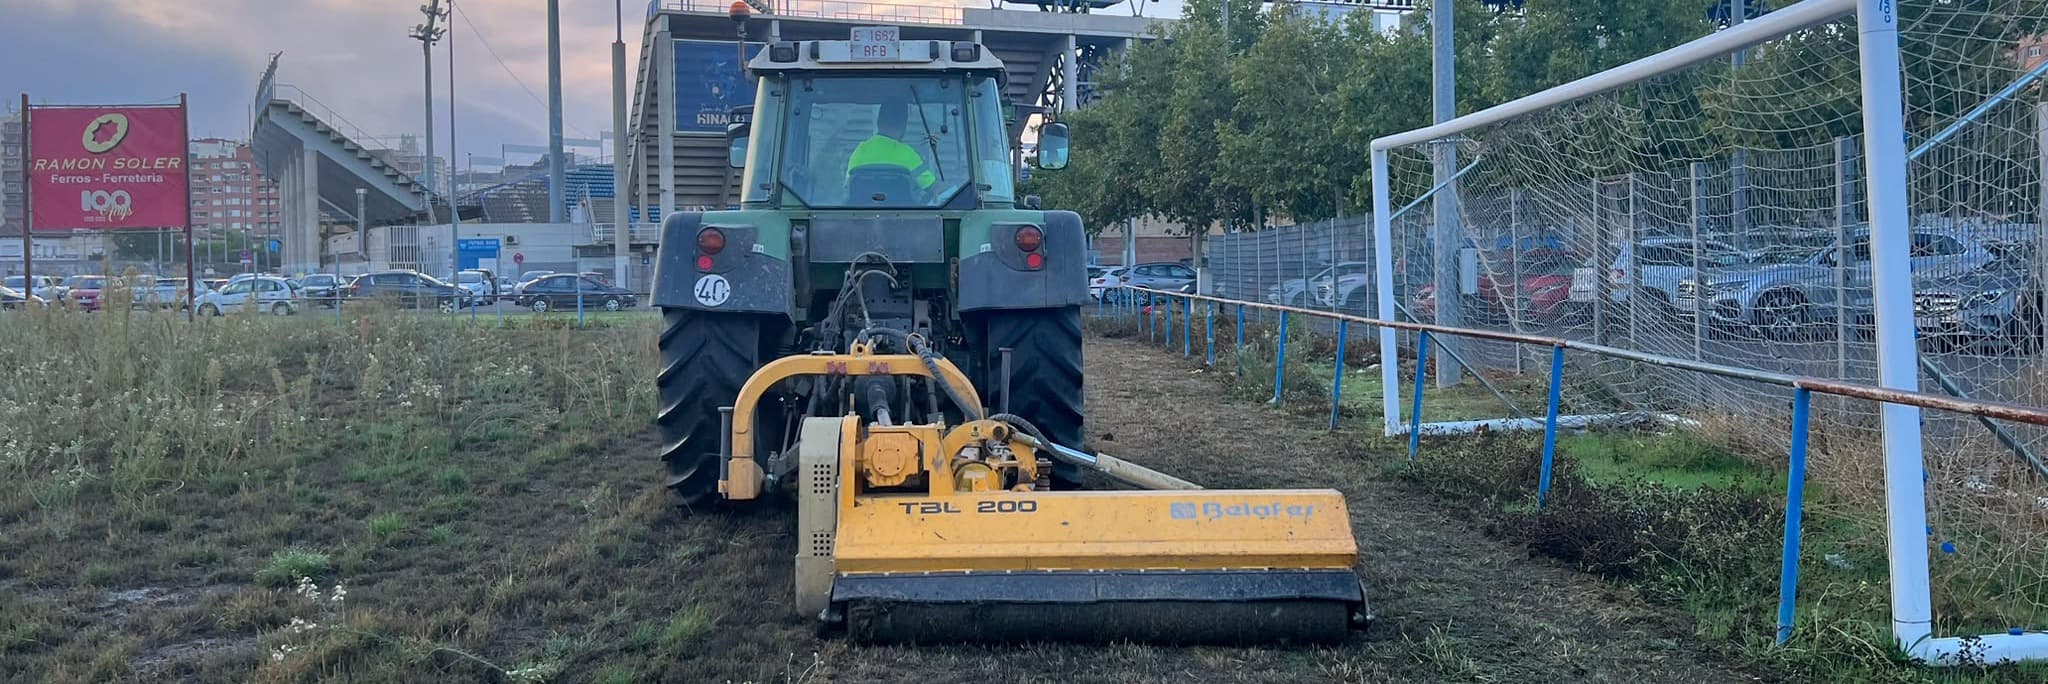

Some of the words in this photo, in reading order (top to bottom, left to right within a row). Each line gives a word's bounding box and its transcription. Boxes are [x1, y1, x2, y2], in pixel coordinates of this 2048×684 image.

[853, 31, 861, 42] E
[34, 158, 105, 171] RAMON
[113, 157, 181, 170] SOLER
[51, 174, 91, 184] Ferros
[81, 189, 131, 212] 100
[698, 278, 725, 302] 40
[898, 501, 961, 514] TBL
[977, 500, 1037, 513] 200
